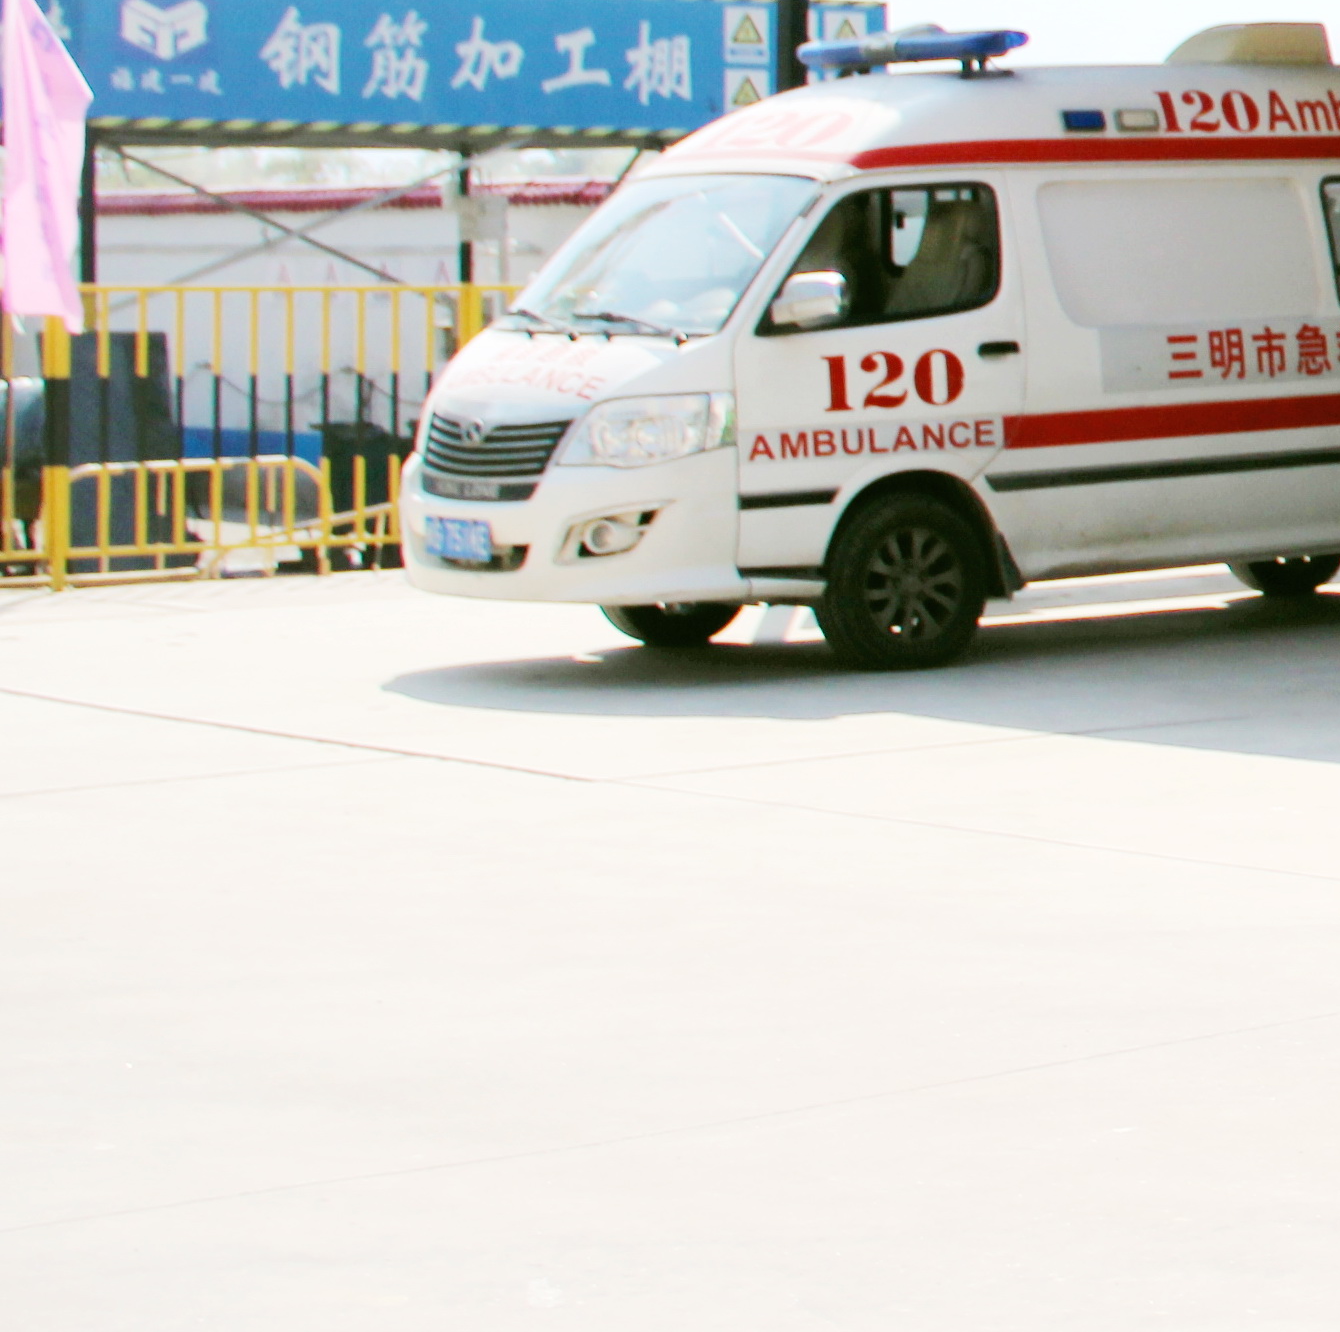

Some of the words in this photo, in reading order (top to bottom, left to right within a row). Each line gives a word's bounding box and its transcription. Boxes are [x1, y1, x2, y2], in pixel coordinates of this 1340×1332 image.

[259, 4, 693, 105] 钢筋加工棚
[1155, 90, 1262, 134] 120
[823, 348, 966, 413] 120
[748, 418, 997, 461] AMBULANCE
